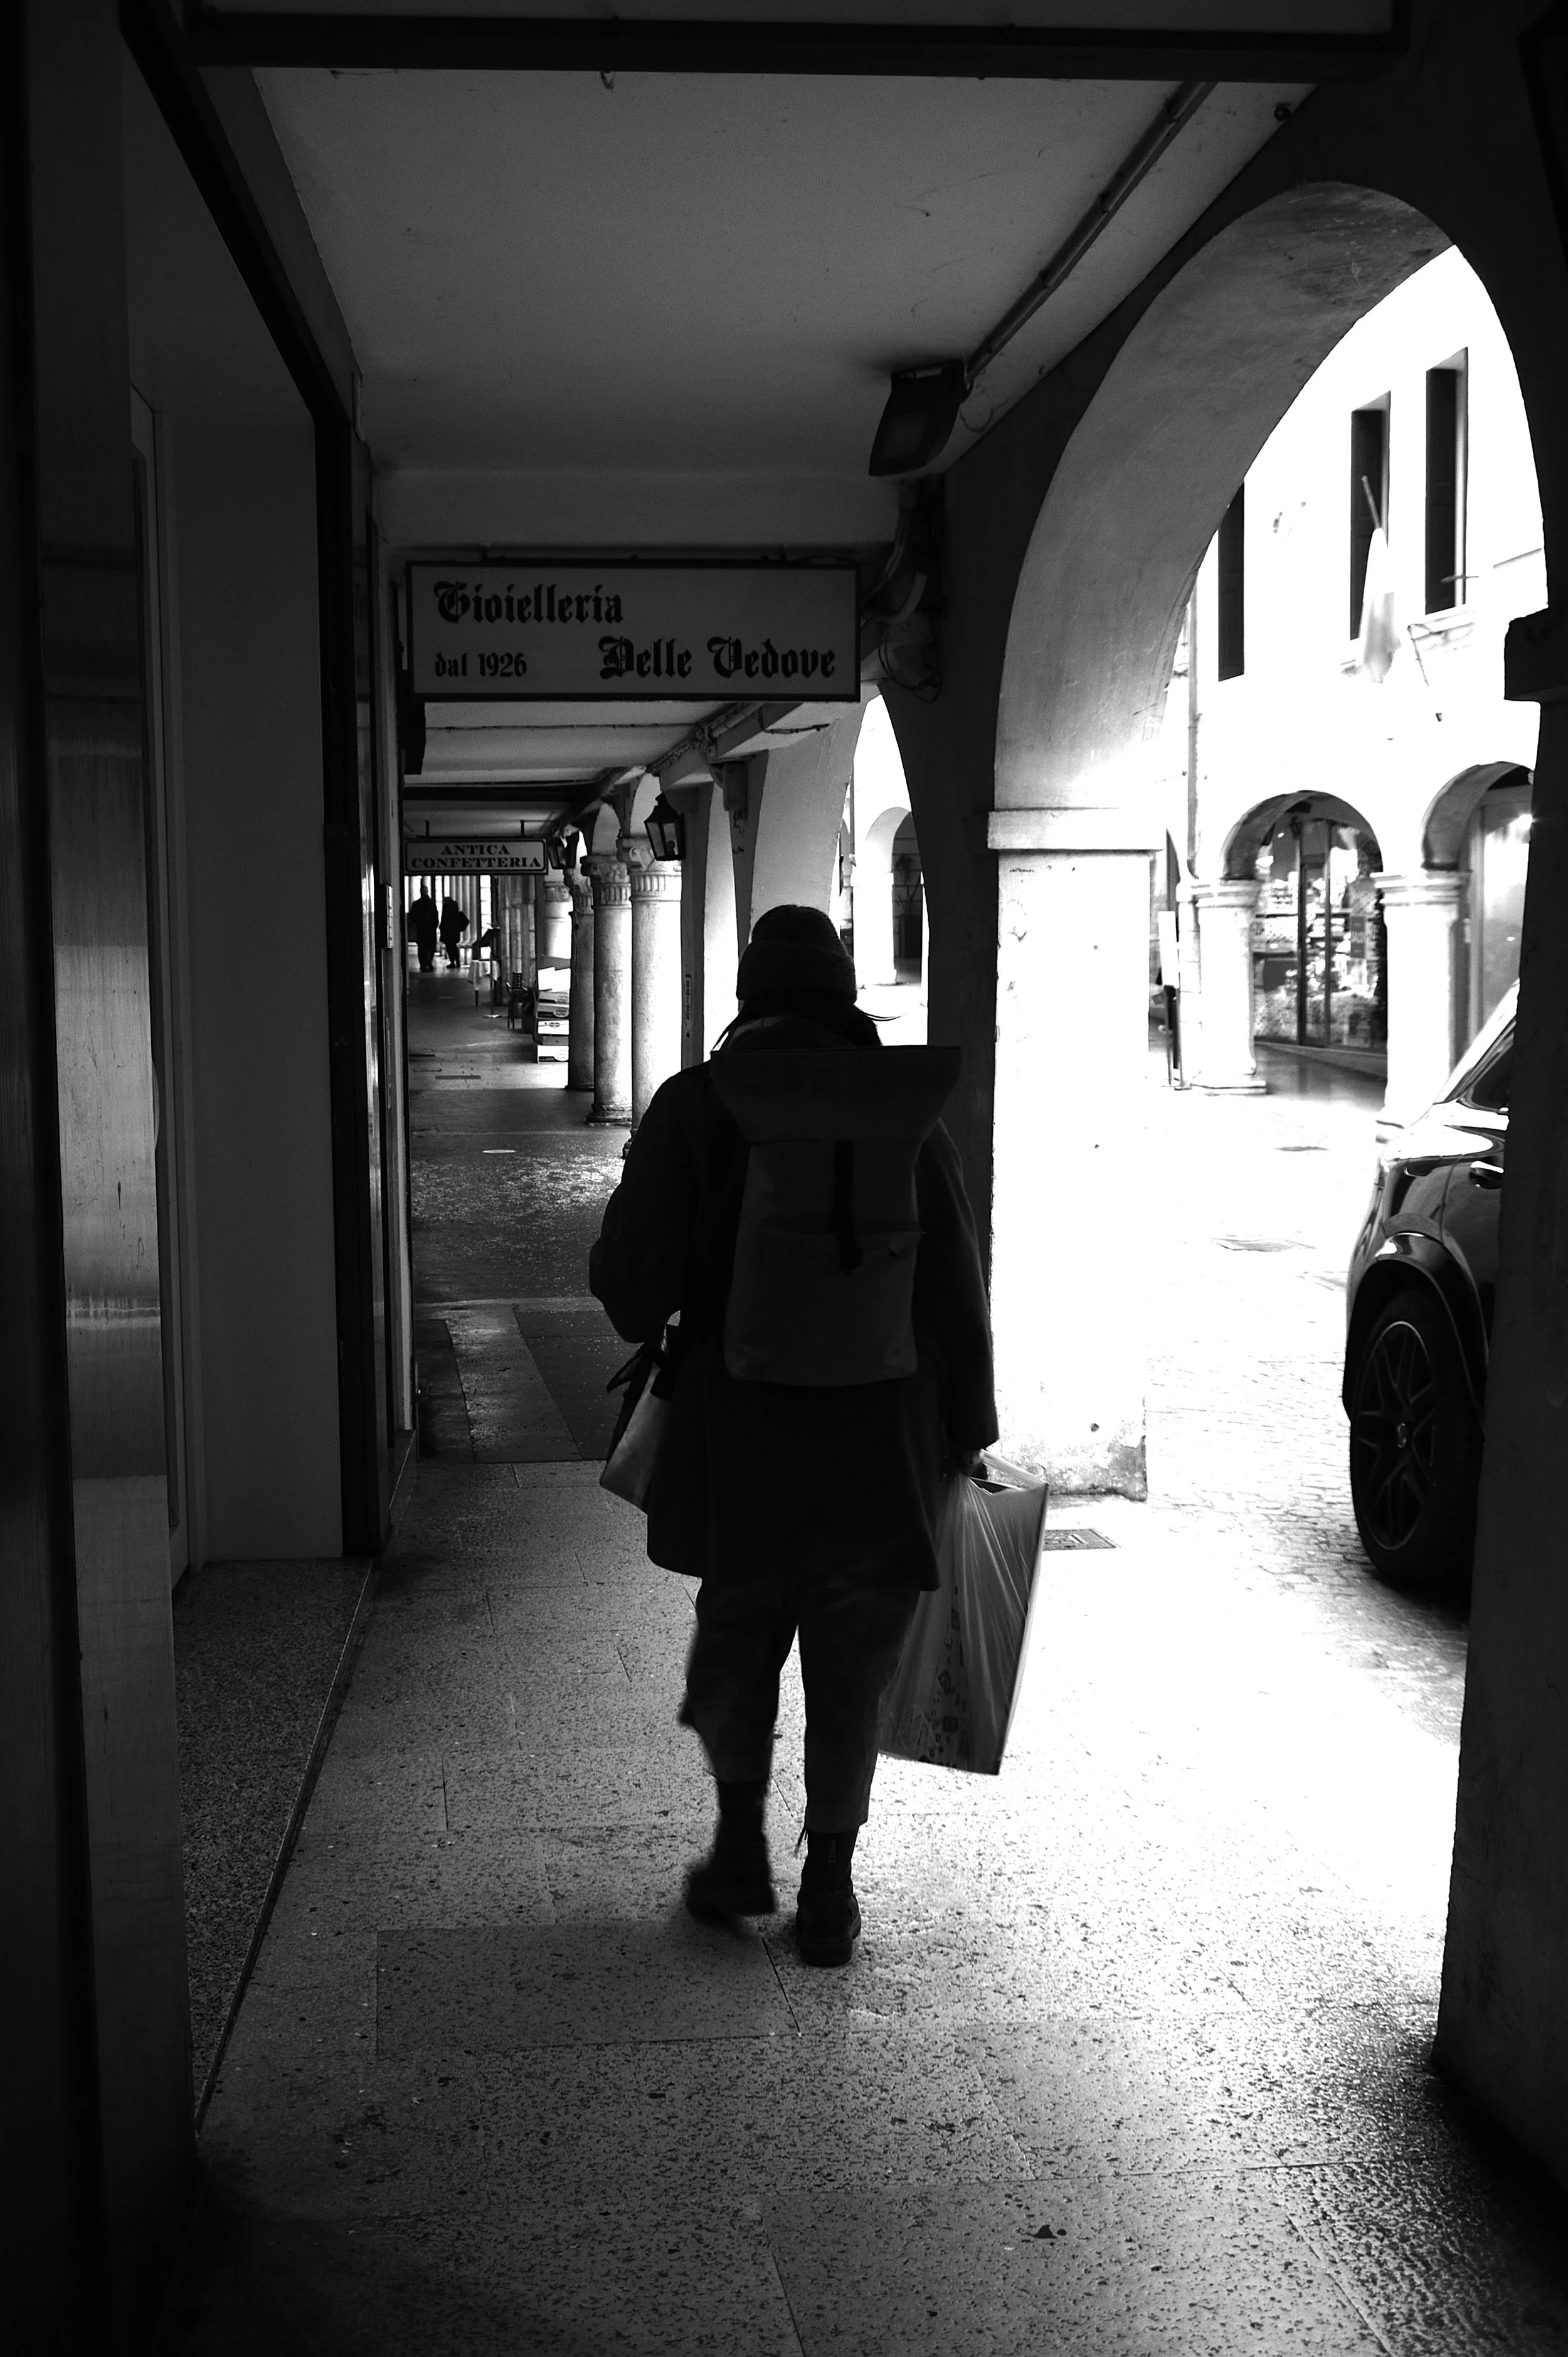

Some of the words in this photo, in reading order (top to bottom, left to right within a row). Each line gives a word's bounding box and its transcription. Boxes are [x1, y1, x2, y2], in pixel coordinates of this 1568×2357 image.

[433, 581, 623, 623] Gioielleria
[435, 652, 467, 678] dal
[478, 652, 527, 678] 1926
[598, 636, 692, 679] Delle
[707, 636, 835, 678] Vedove
[441, 844, 509, 854] ANTICA
[411, 857, 541, 868] CONFETTERIA
